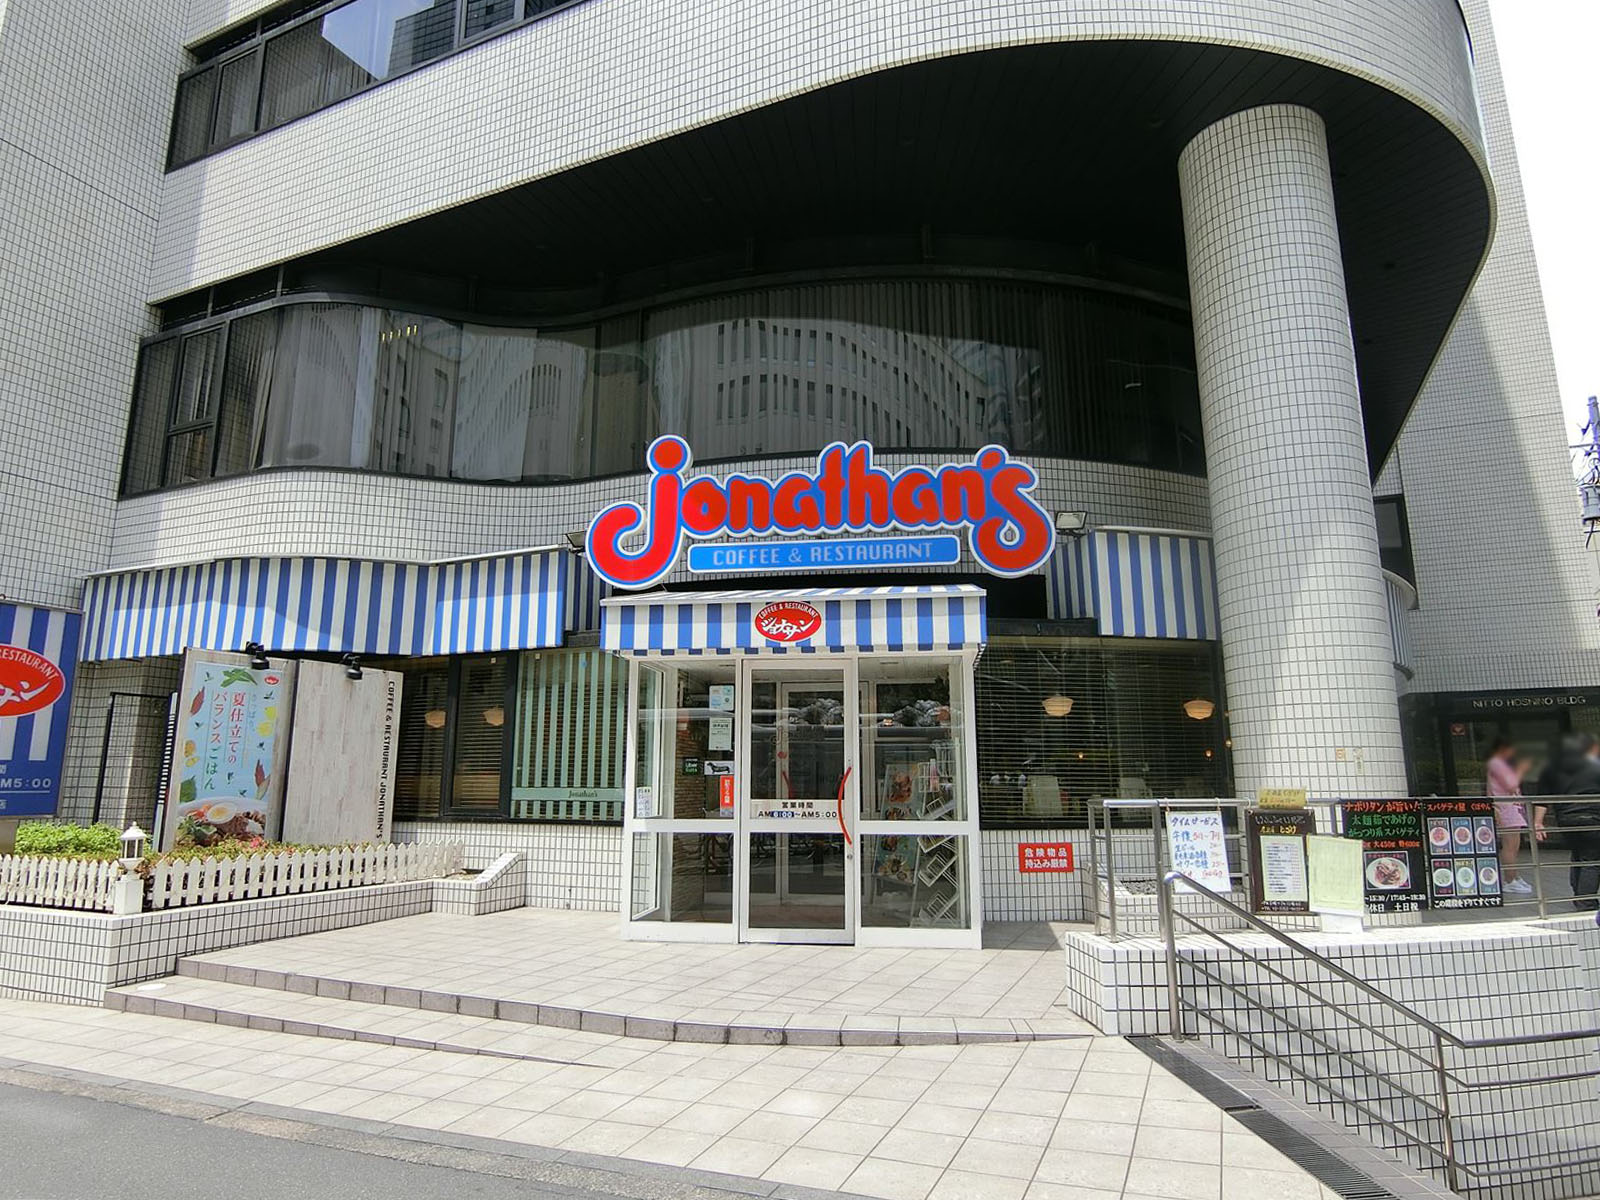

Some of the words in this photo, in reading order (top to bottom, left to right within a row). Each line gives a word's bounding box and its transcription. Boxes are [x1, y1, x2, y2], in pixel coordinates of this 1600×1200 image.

[713, 549, 781, 566] COFFEE
[788, 548, 803, 563] &
[810, 542, 934, 562] RESTAURANT
[758, 604, 777, 619] COFFEE
[784, 602, 819, 618] RESTAURANT
[760, 616, 815, 641] ジョナサン
[0, 648, 59, 680] ESTAURANT
[386, 681, 395, 712] COFFEE
[1472, 699, 1503, 708] NITTO
[1507, 697, 1553, 706] HOSHINO
[228, 691, 246, 764] 夏仕立ての
[385, 714, 392, 722] &
[204, 690, 228, 790] バランスごはん
[381, 724, 392, 779] RESTAURANT
[377, 782, 387, 838] JONATHAN'S
[782, 801, 813, 809] 営業時間
[1171, 816, 1219, 827] タイムサービス
[1025, 847, 1067, 857] 危険物品
